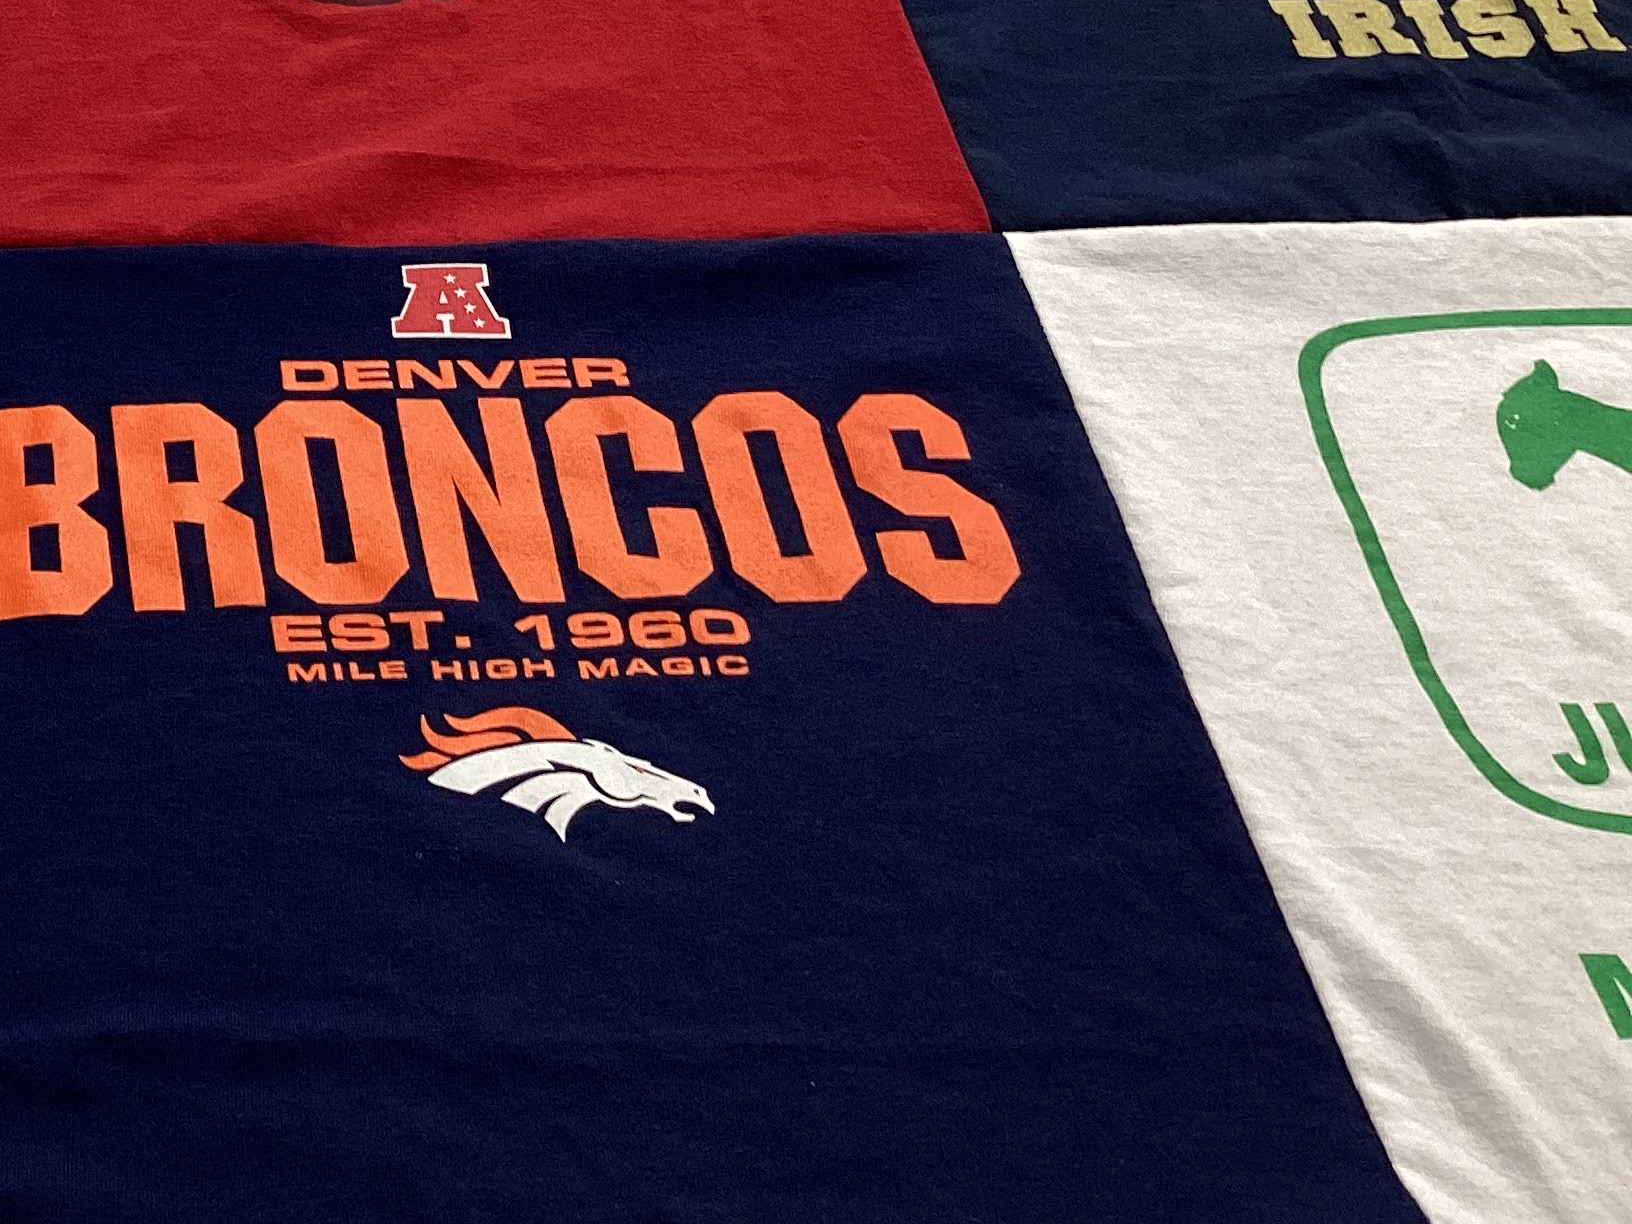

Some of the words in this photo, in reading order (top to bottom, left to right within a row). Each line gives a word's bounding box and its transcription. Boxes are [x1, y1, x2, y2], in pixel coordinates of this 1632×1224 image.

[280, 357, 632, 393] DENVER
[271, 611, 471, 653] EST.
[514, 610, 750, 647] 1960
[287, 657, 408, 682] MILE
[432, 655, 557, 680] HIGH
[577, 654, 751, 679] MAGIC
